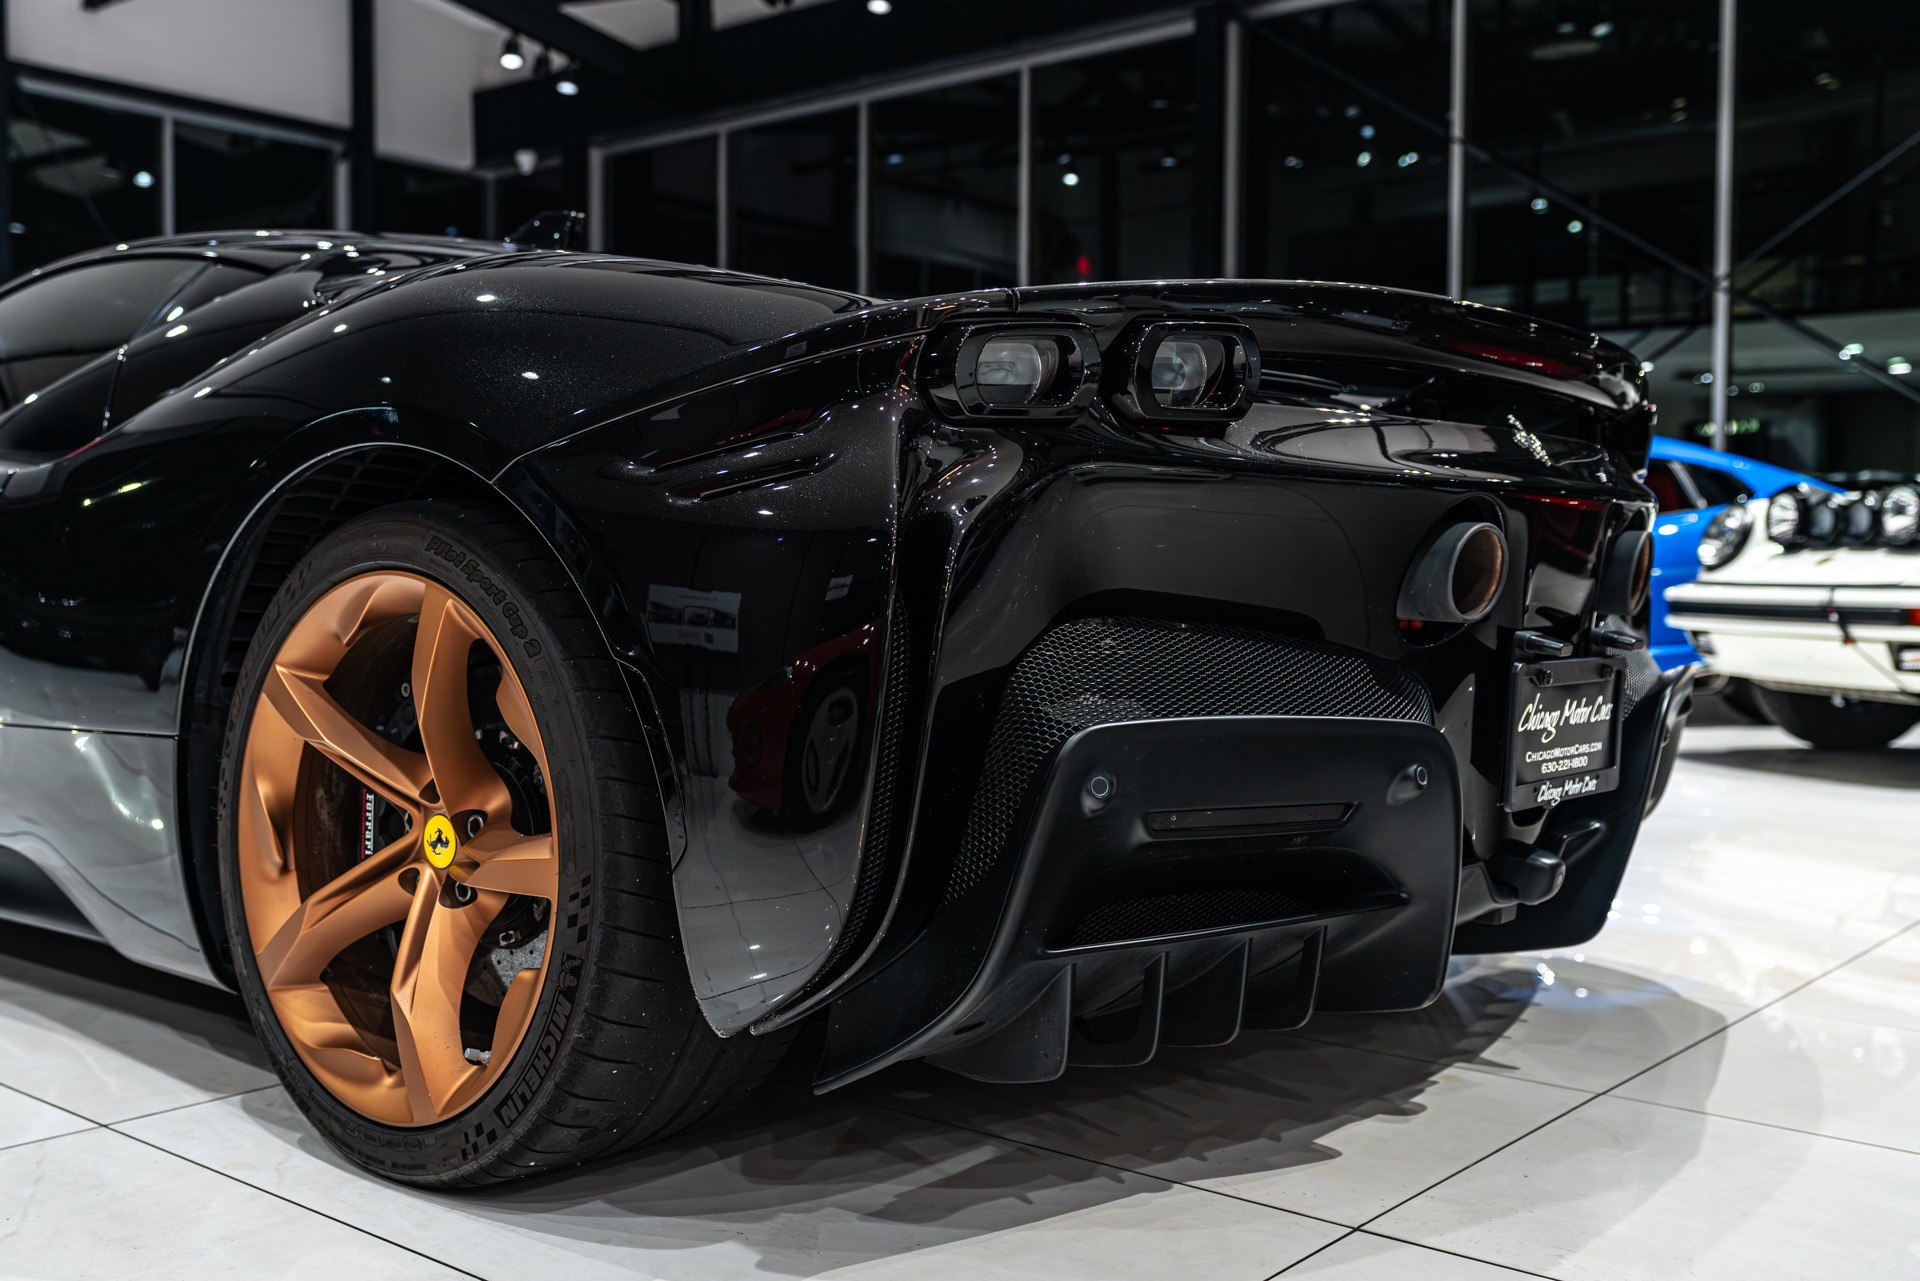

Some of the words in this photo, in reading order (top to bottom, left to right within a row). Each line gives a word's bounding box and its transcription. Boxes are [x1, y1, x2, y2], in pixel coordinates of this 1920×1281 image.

[424, 535, 467, 568] Pilot
[461, 558, 507, 606] Sport
[502, 601, 528, 640] Cup
[523, 638, 541, 658] 2
[1518, 693, 1560, 743] Chicago
[1560, 698, 1592, 726] Motor
[1590, 695, 1613, 722] Cars
[1562, 778, 1583, 796] Motor
[1582, 776, 1597, 793] Cars
[365, 793, 374, 855] Ferrari
[501, 996, 573, 1128] MICHELIN
